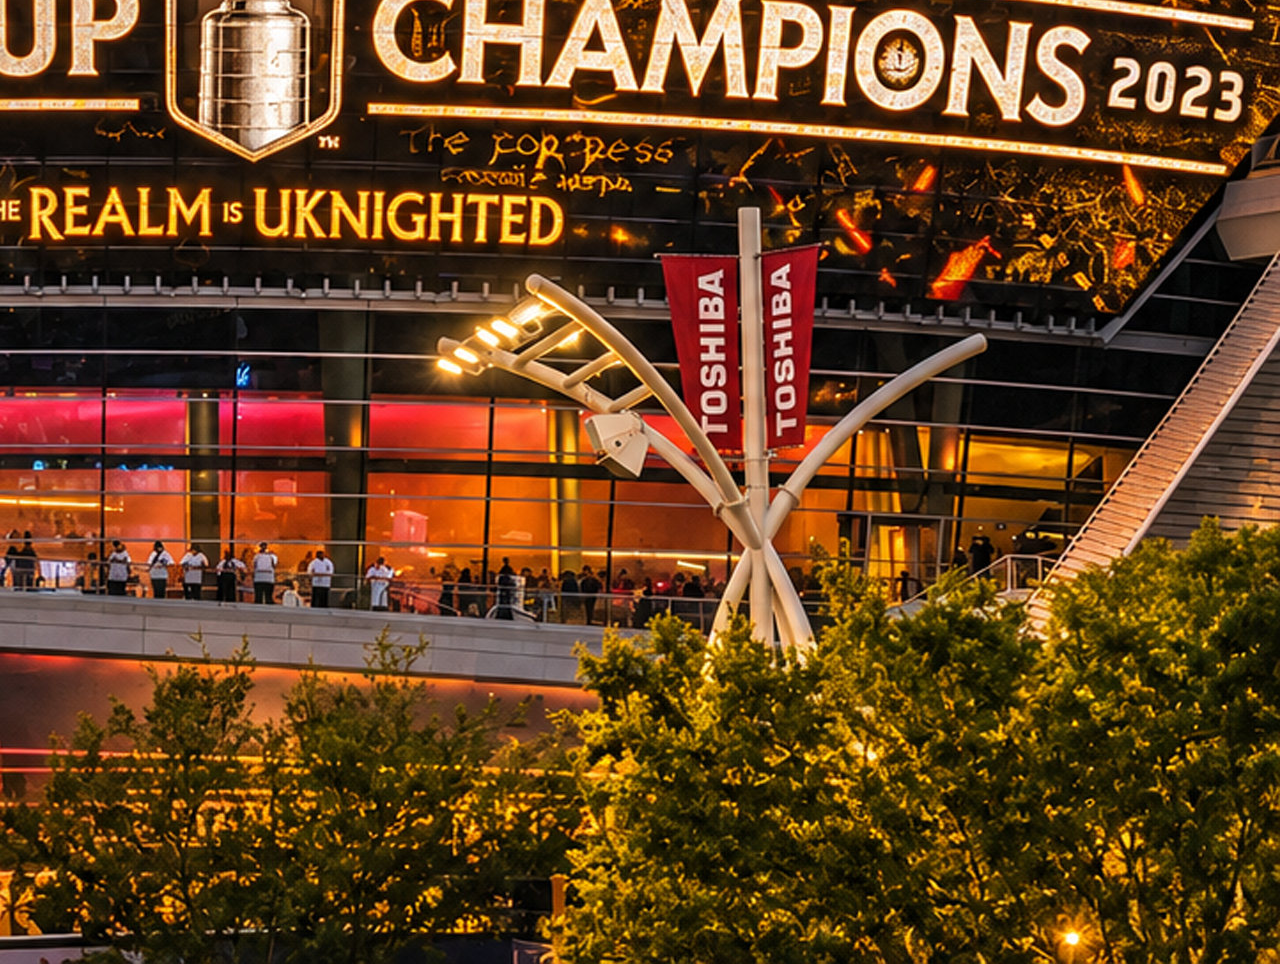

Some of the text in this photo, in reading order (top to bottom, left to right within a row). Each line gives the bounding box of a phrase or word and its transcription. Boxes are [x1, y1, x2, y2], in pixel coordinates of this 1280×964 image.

[1107, 56, 1245, 122] 2023
[28, 187, 213, 241] REALM
[223, 202, 244, 224] IS
[254, 188, 565, 246] UKNIGHTED
[698, 269, 728, 434] TOSHIBA
[770, 263, 808, 437] TOSHIBA
